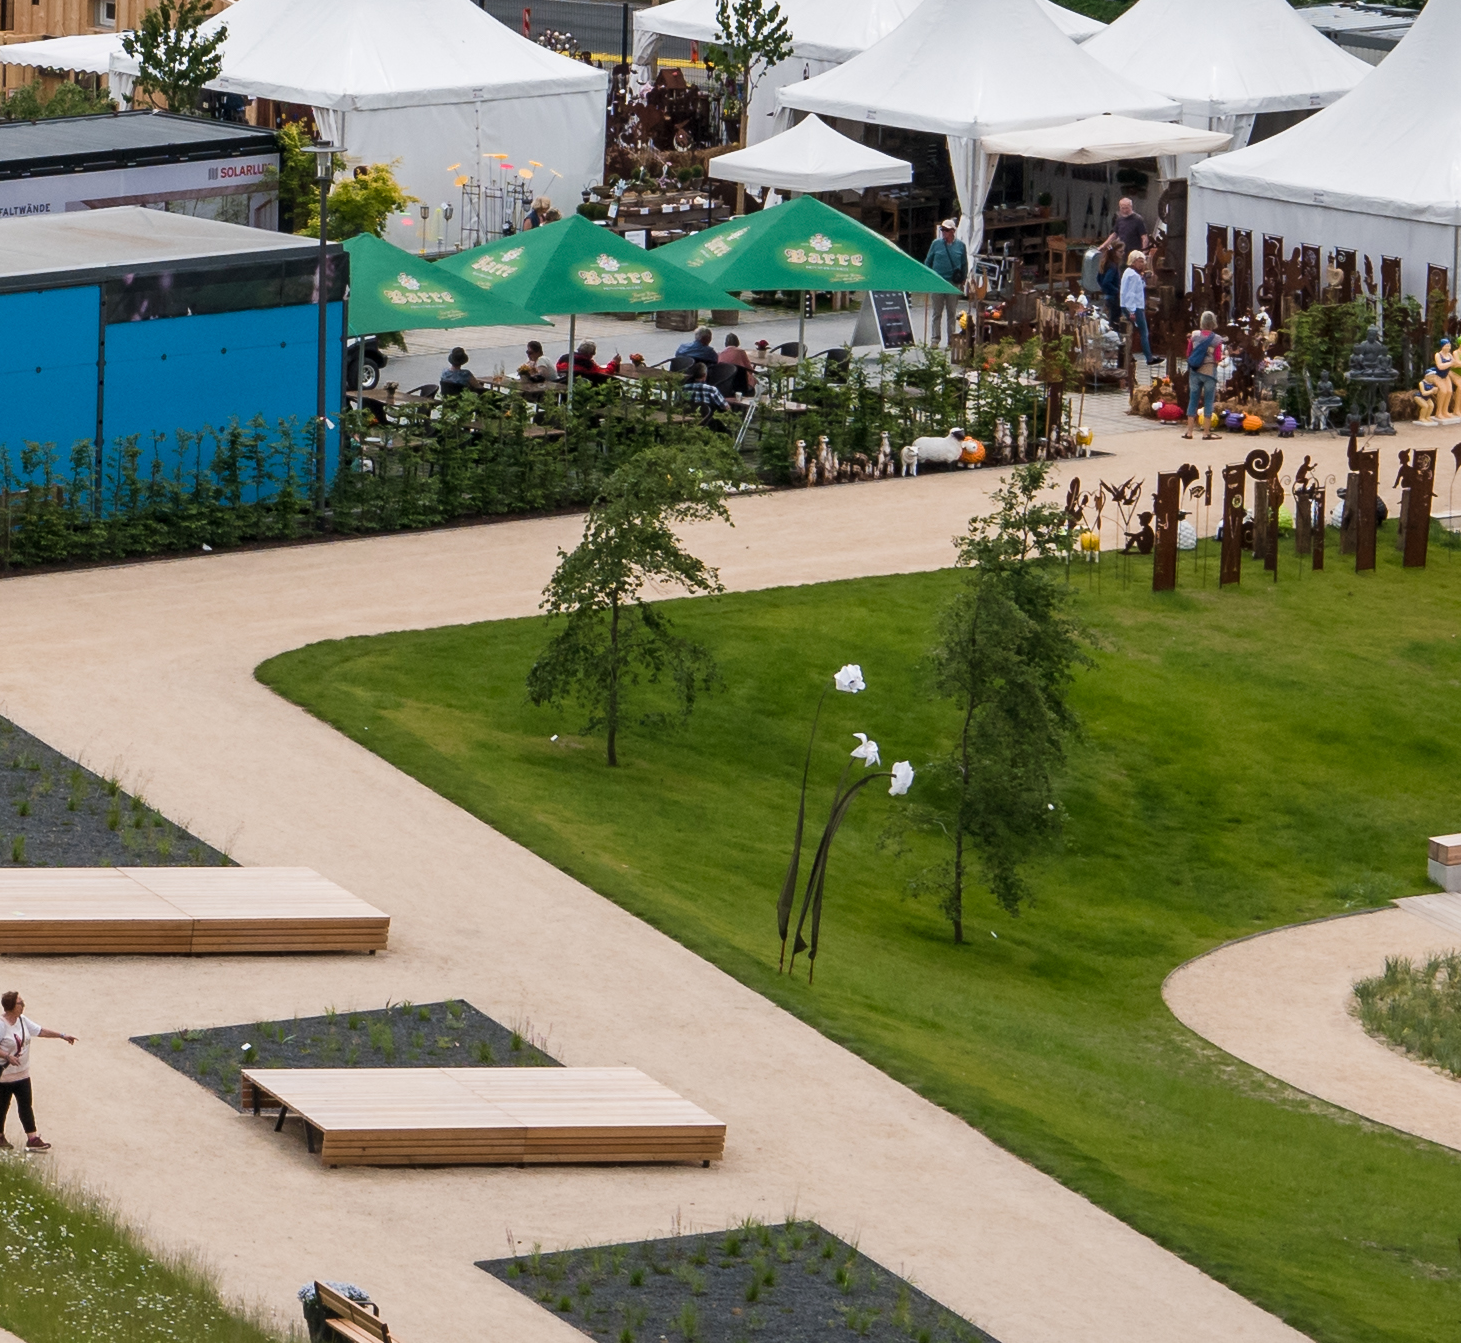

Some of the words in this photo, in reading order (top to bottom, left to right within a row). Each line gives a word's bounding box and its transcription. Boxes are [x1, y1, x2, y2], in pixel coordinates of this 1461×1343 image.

[471, 254, 518, 278] Barre
[784, 248, 863, 267] Barre
[578, 270, 654, 285] Barre
[383, 289, 455, 304] Barre
